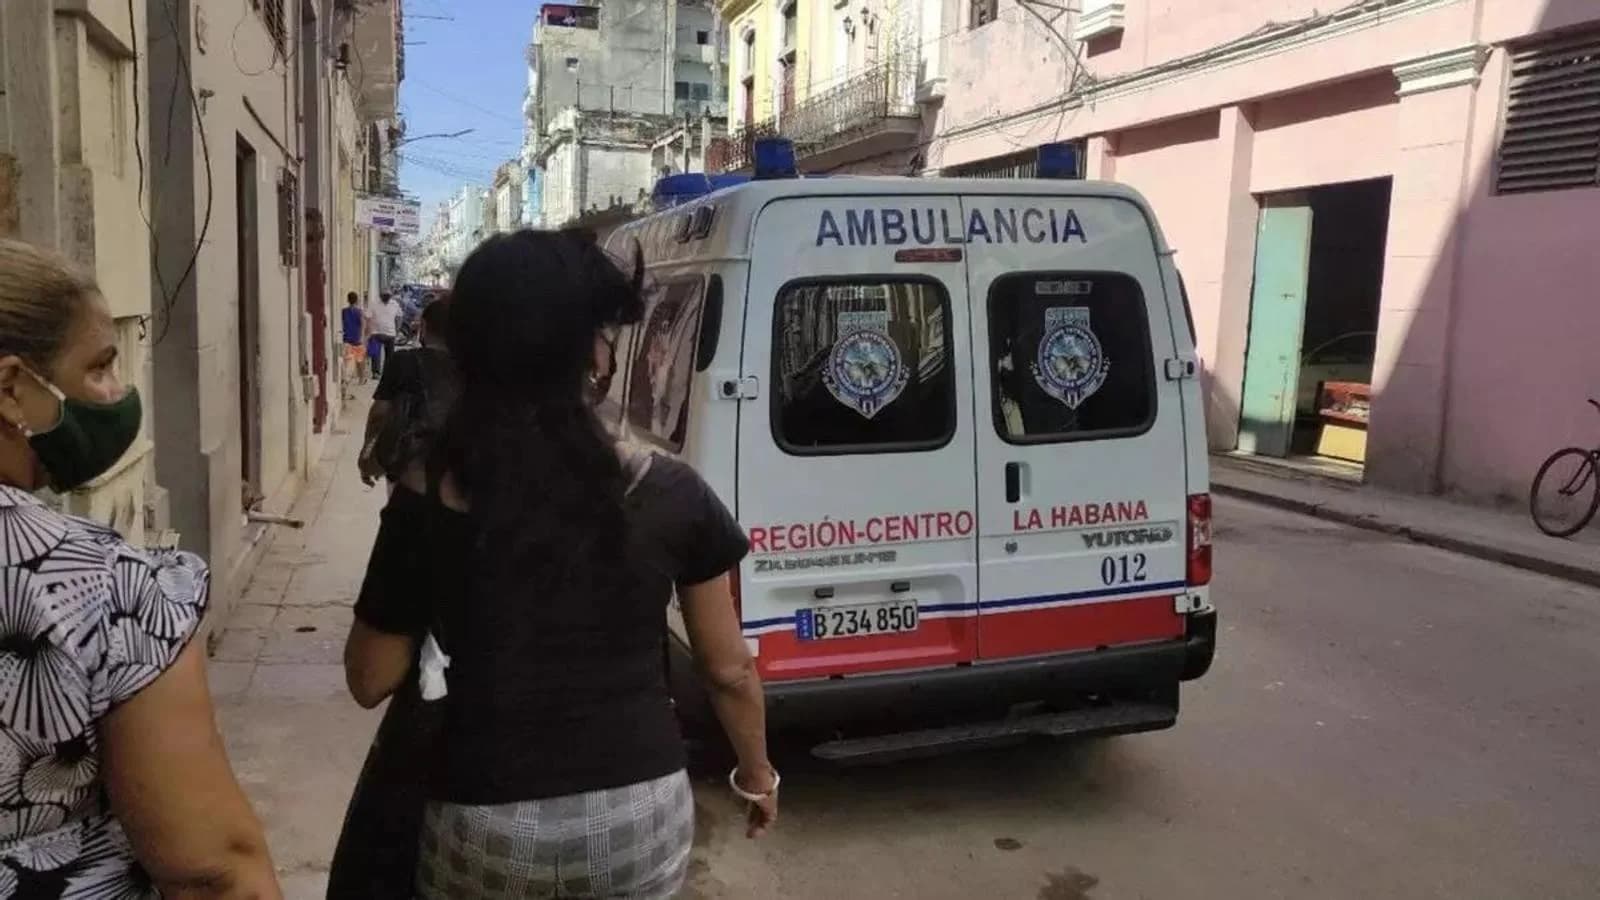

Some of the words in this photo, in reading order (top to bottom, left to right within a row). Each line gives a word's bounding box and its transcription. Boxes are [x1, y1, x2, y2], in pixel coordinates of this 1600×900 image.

[815, 207, 1087, 246] AMBULANCIA
[747, 510, 973, 553] REGIÓN-CENTRO
[1014, 508, 1043, 531] LA
[1051, 500, 1149, 527] HABANA
[1101, 553, 1147, 585] 012
[814, 613, 828, 638] B
[832, 609, 872, 636] 234
[877, 605, 916, 631] 850
